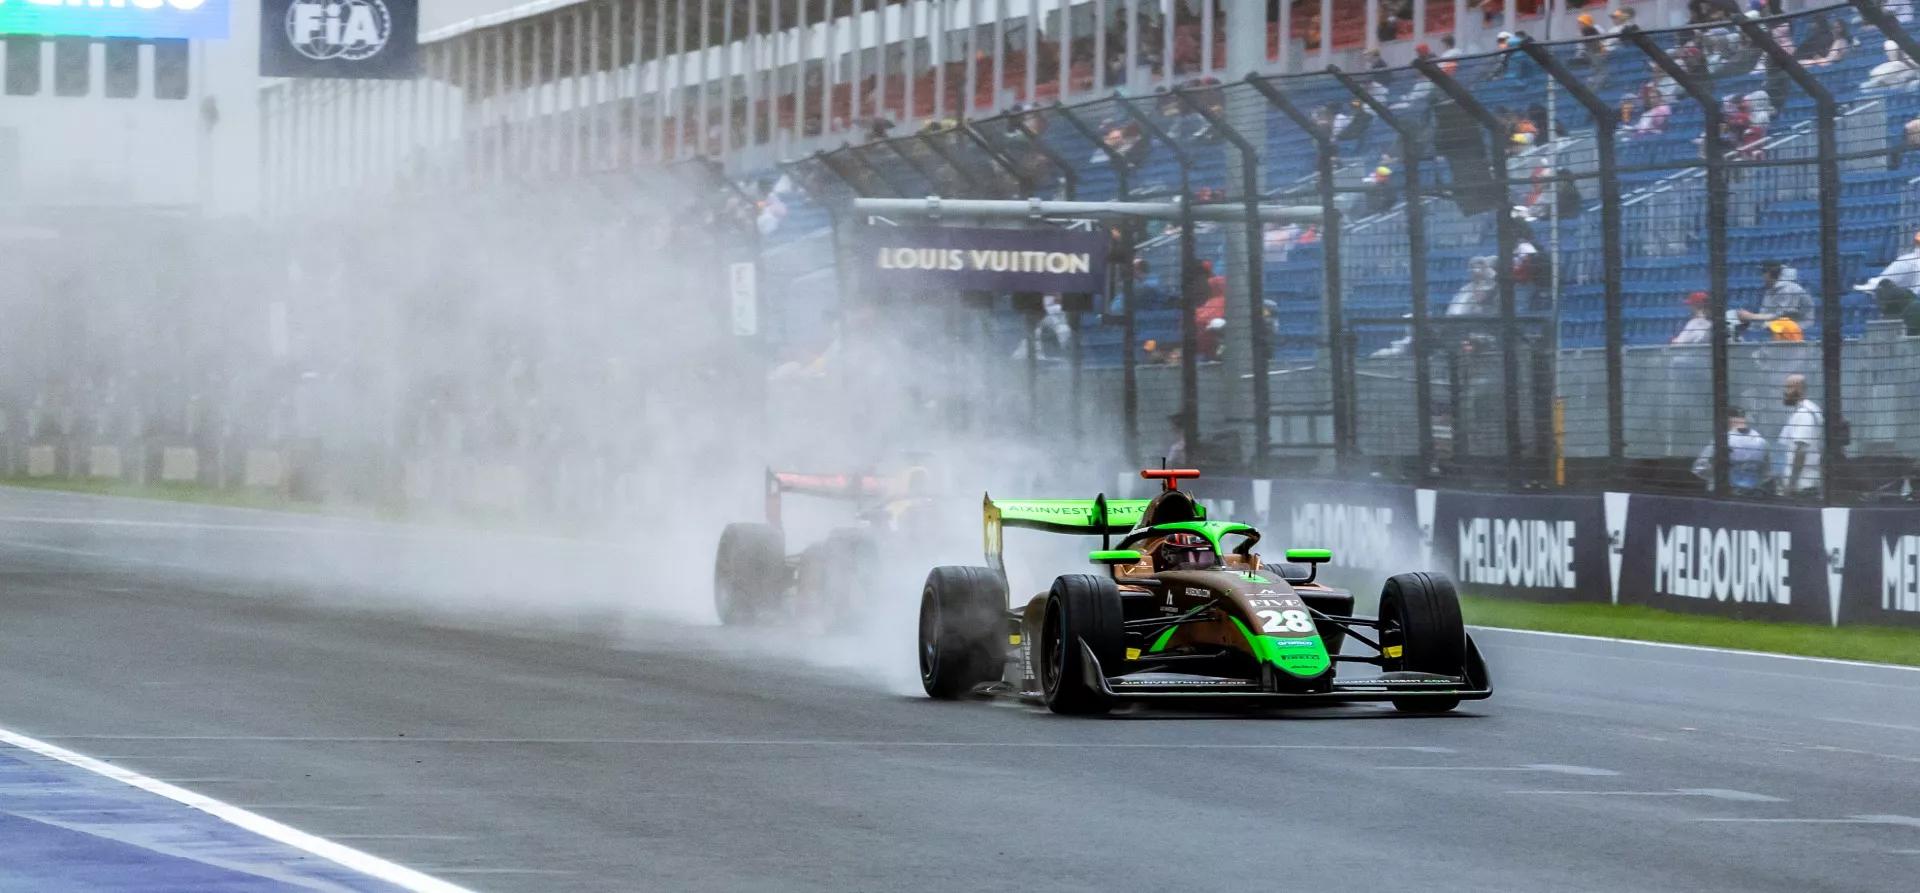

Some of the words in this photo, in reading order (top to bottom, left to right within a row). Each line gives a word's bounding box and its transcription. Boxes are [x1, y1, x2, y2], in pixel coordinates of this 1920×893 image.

[879, 247, 963, 270] LOUIS
[969, 249, 1090, 274] VUITTON
[1458, 517, 1576, 588] MELBOURNE
[1655, 524, 1792, 604] MELBOURNE
[1256, 609, 1315, 633] 28
